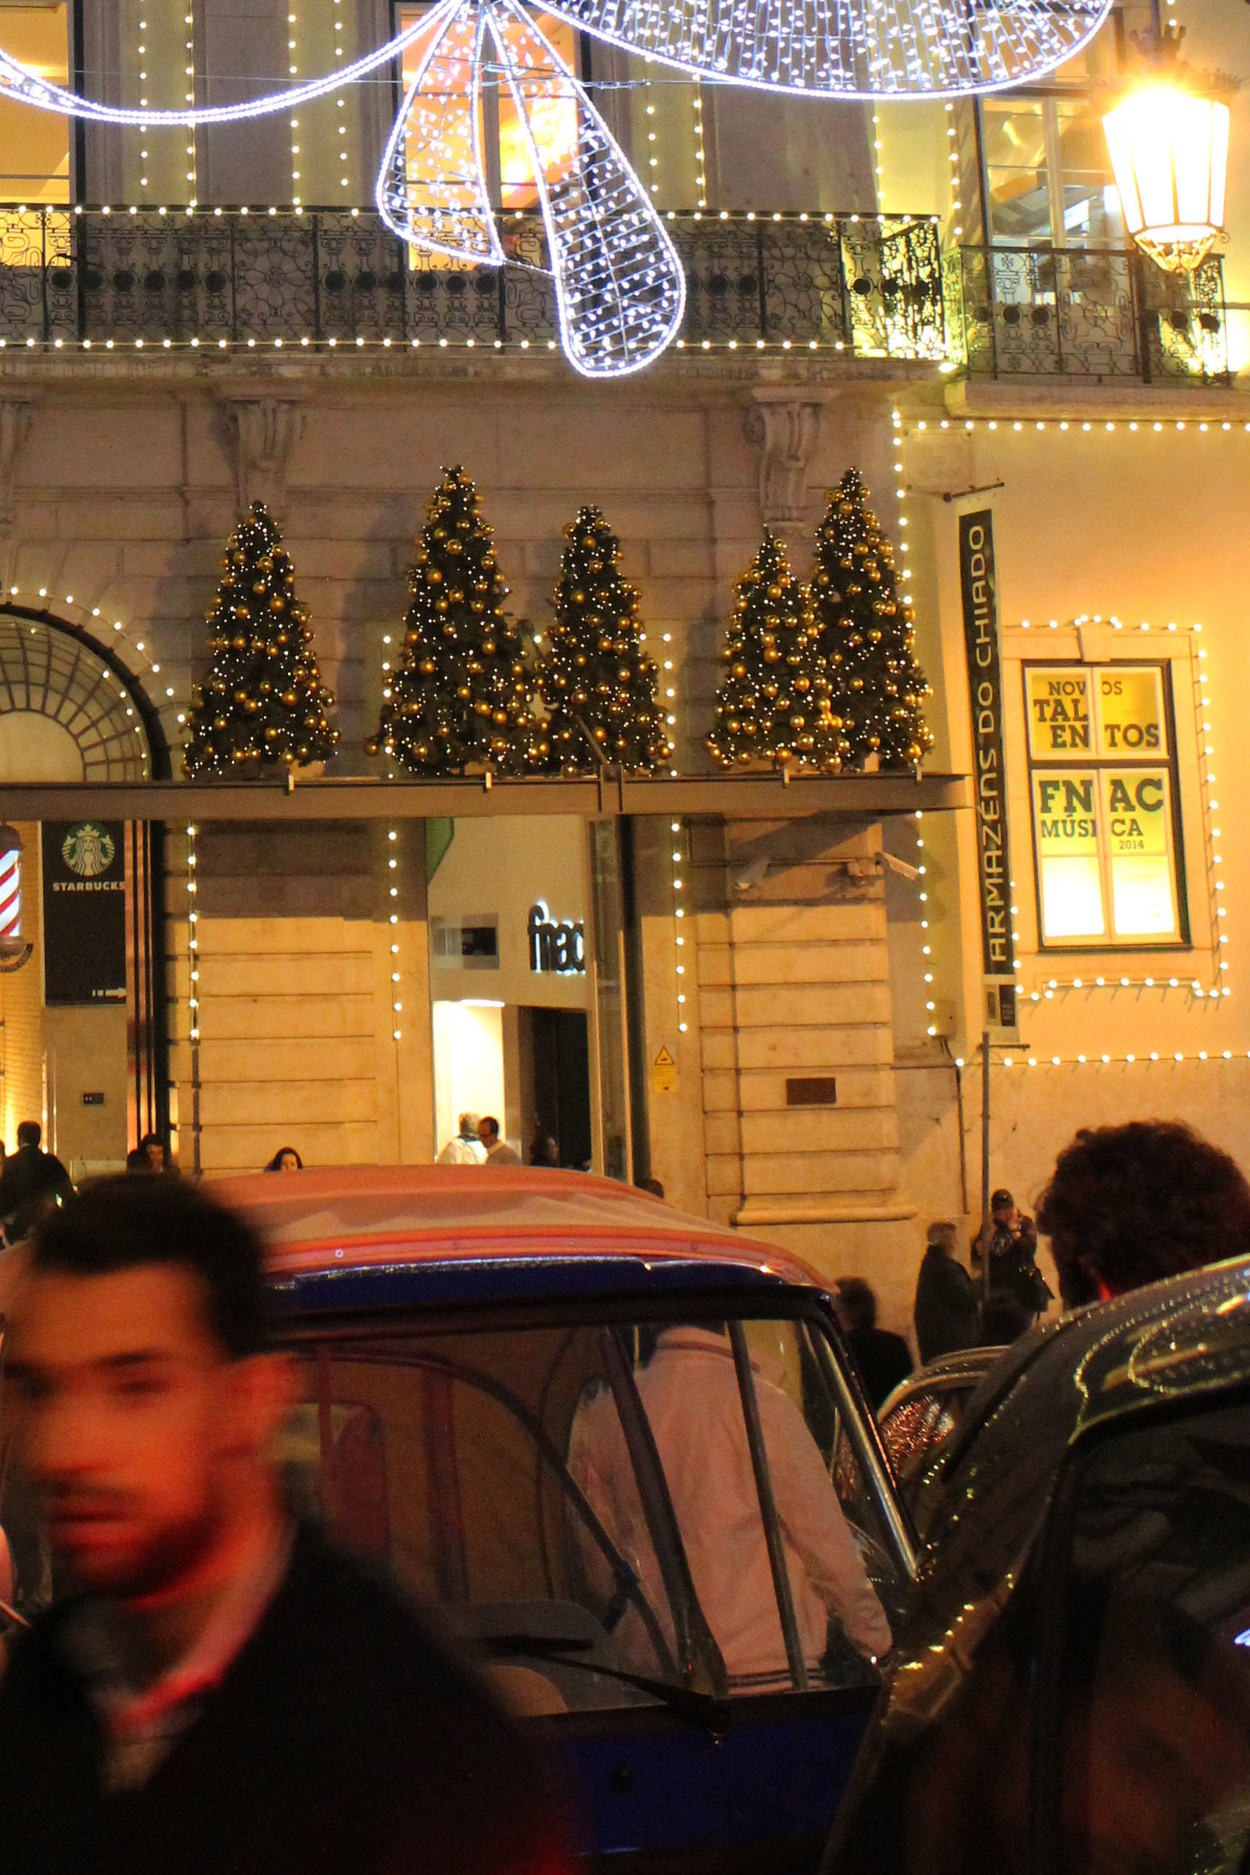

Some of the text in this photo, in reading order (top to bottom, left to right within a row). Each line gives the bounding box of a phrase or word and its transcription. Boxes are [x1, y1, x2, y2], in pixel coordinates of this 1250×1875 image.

[969, 525, 992, 667] CHIADO
[978, 681, 995, 734] DO
[1034, 699, 1089, 723] TAL
[1038, 778, 1164, 814] FNAC
[1119, 840, 1144, 850] 2014
[52, 881, 126, 892] STARBUCKS
